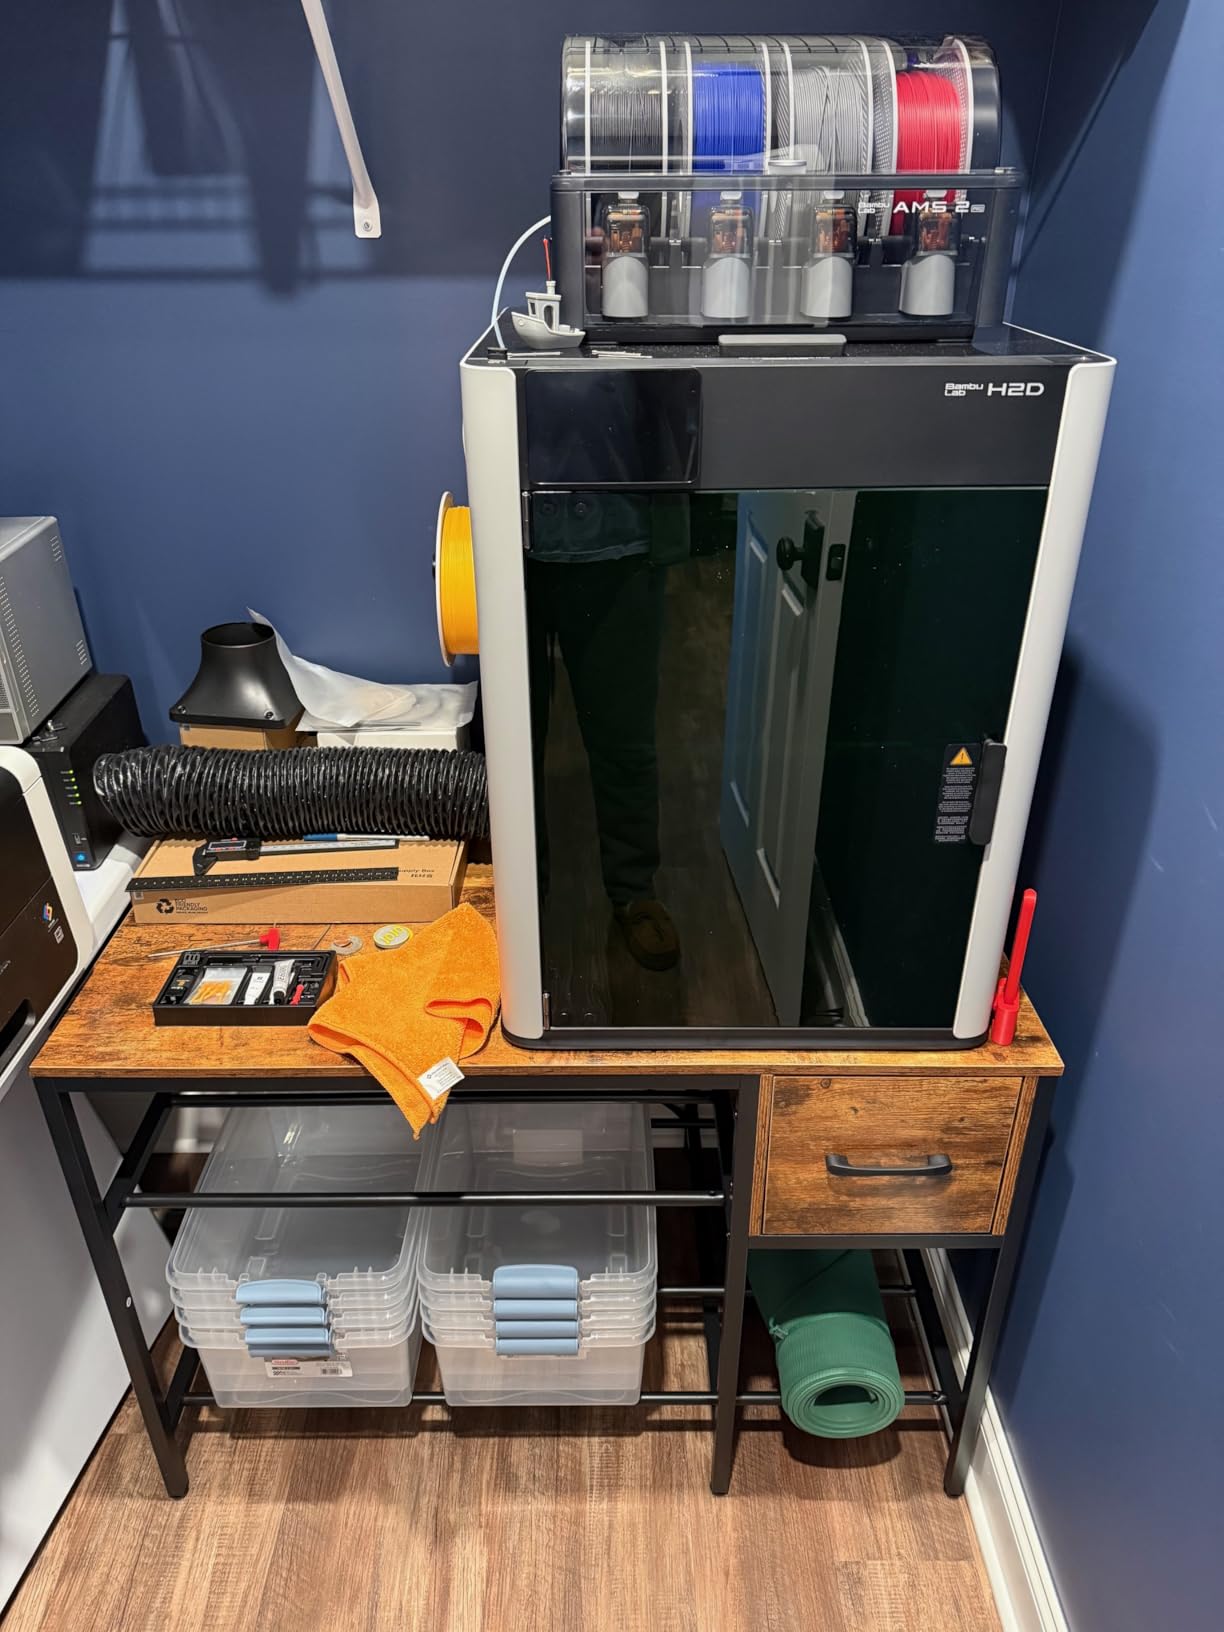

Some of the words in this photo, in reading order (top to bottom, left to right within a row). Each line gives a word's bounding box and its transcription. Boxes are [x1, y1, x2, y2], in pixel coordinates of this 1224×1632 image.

[893, 201, 947, 213] AMS
[955, 201, 970, 213] 2
[944, 389, 967, 397] Lab
[987, 382, 1045, 397] H2D
